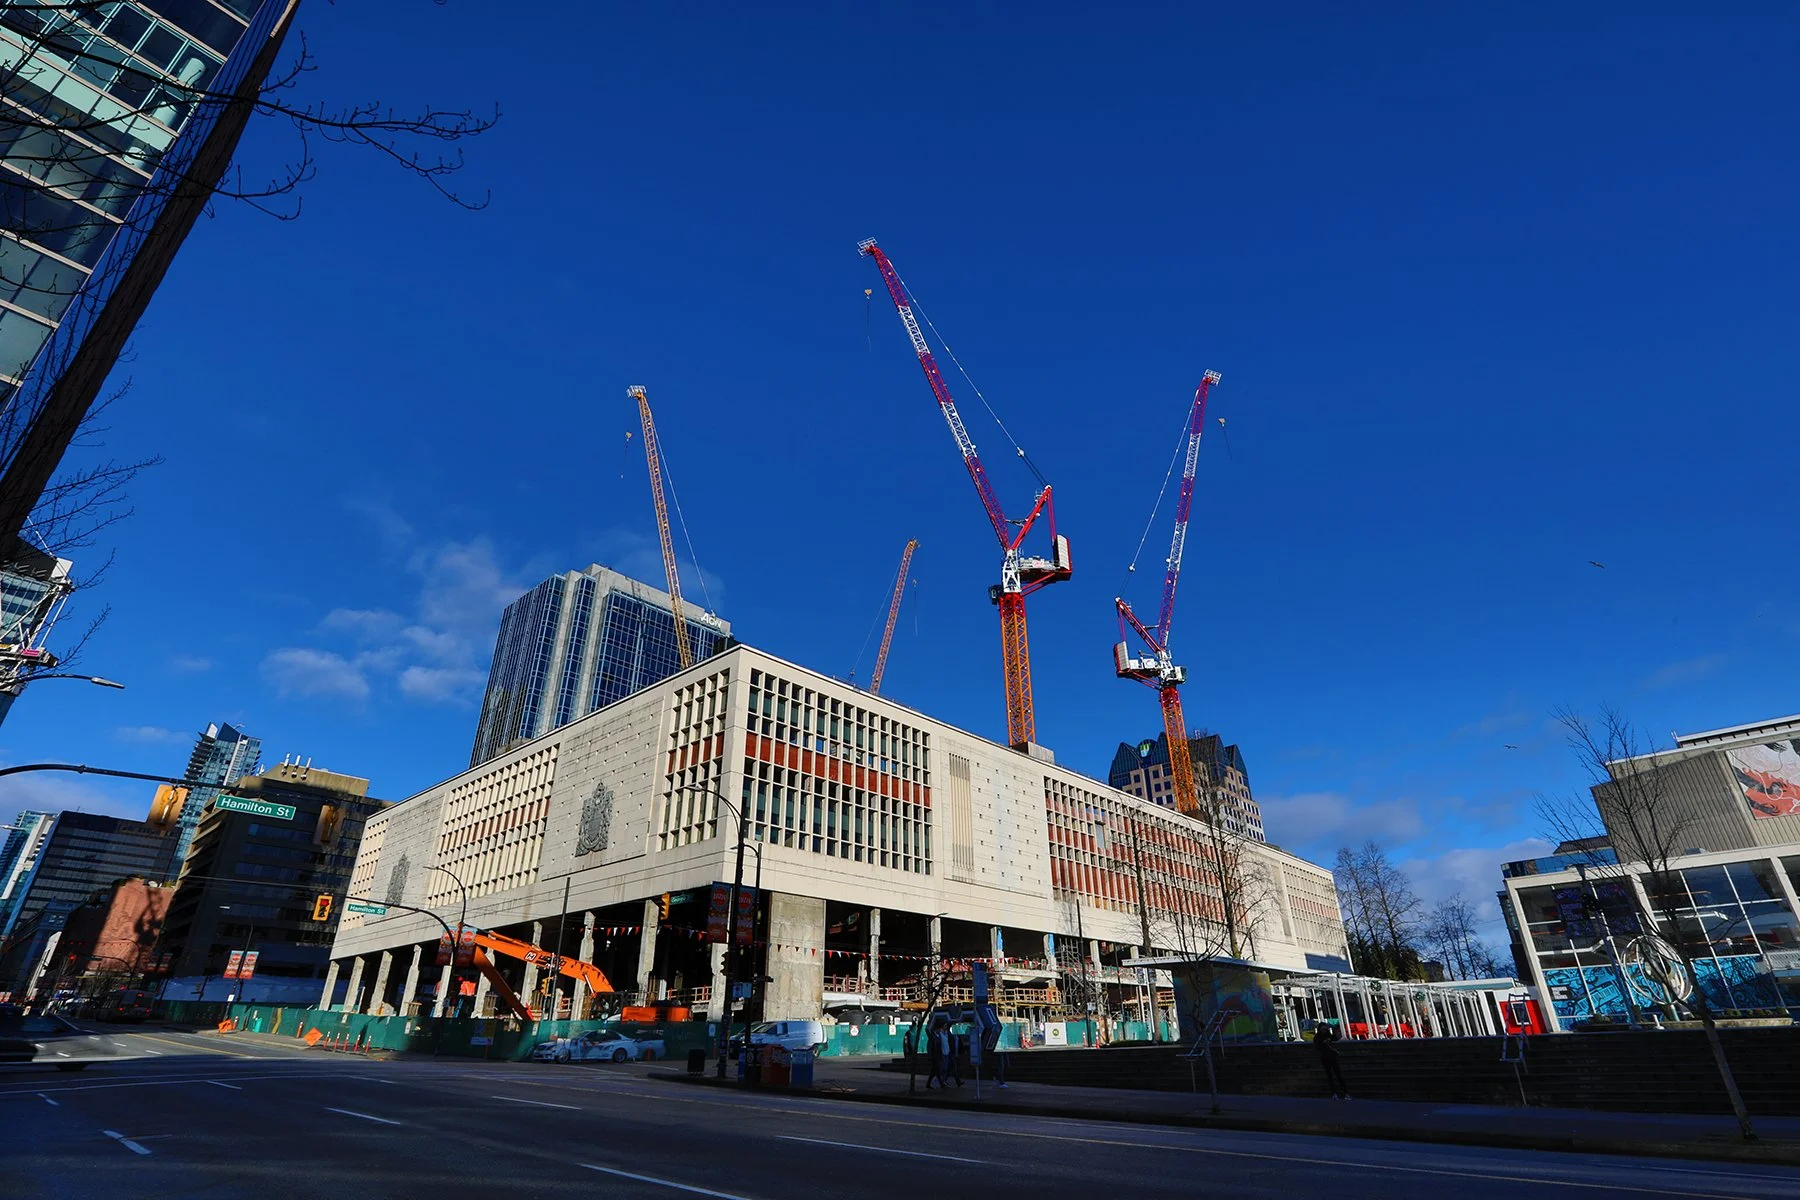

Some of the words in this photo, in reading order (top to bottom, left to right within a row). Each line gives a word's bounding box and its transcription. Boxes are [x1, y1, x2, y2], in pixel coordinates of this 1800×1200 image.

[701, 612, 722, 627] AON
[220, 797, 272, 814] Hamilton
[276, 806, 290, 817] St
[349, 905, 376, 913] Hamilton
